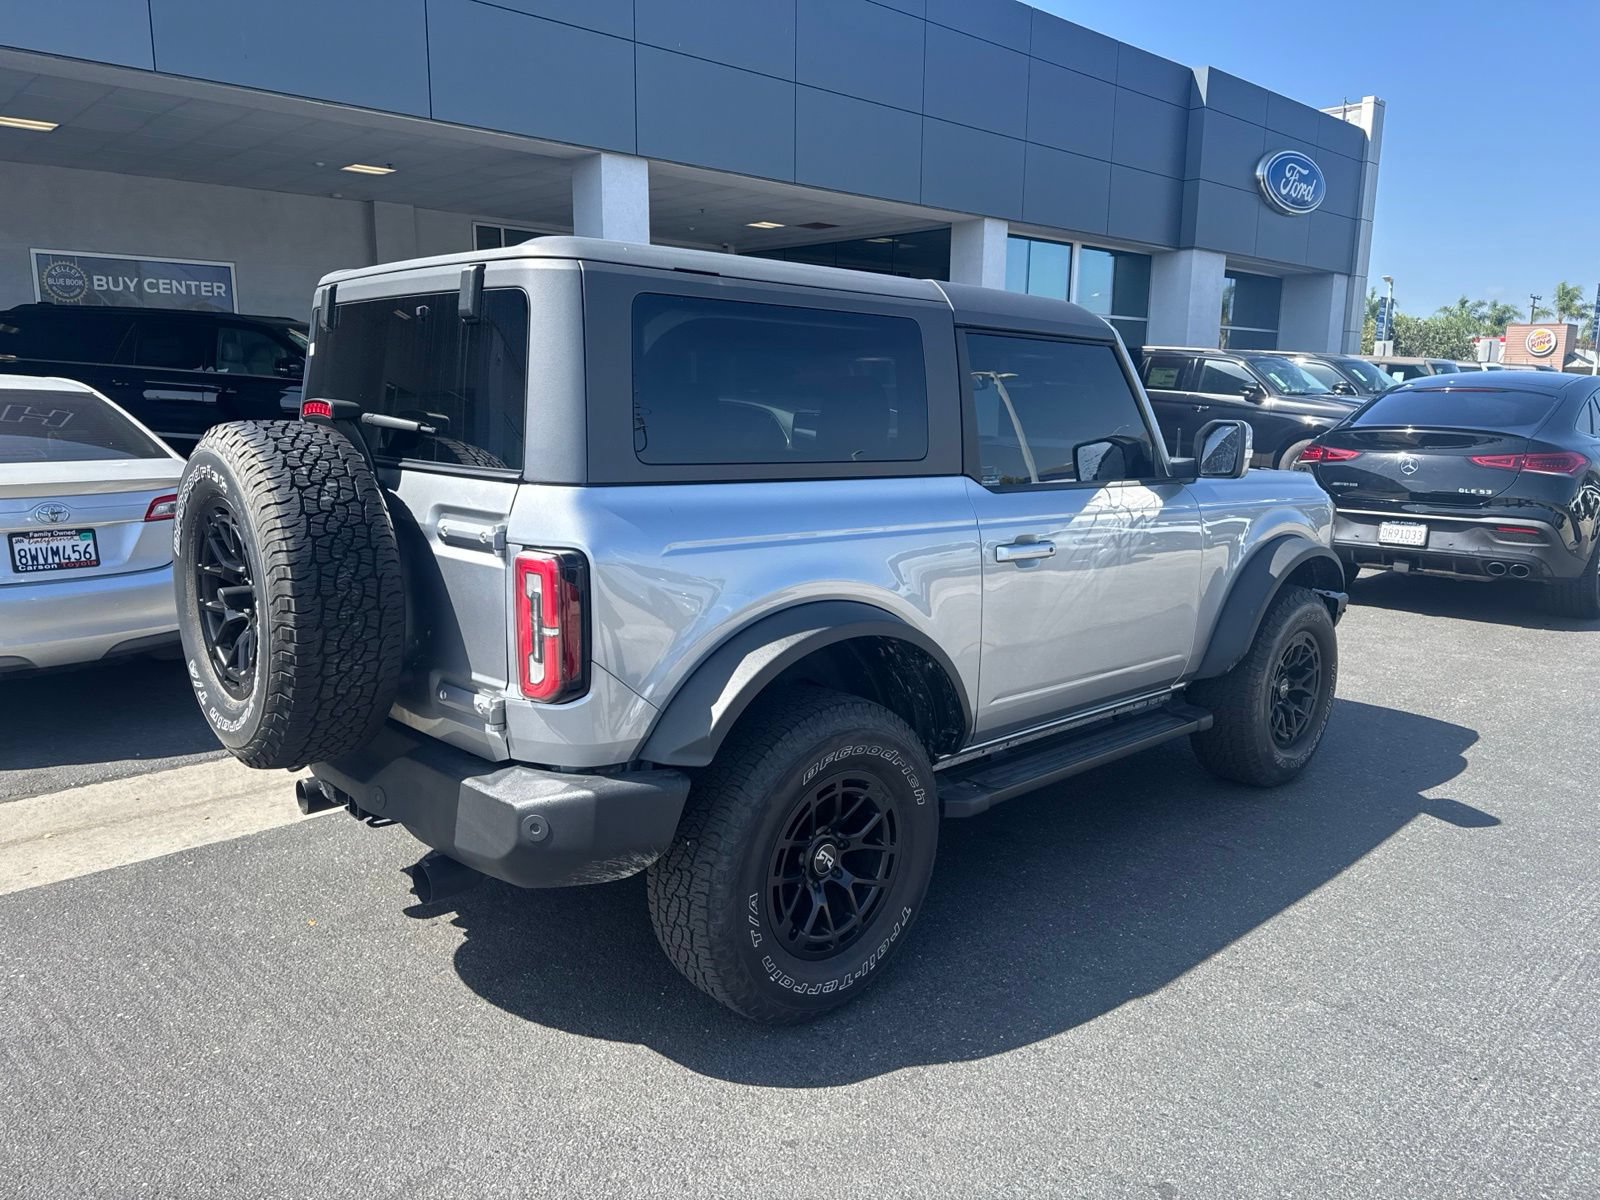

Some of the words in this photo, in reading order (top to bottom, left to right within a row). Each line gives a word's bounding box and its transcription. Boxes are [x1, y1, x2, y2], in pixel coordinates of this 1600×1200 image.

[1280, 163, 1316, 202] Ford
[51, 265, 81, 278] KELLEY
[47, 277, 65, 286] BLUE
[65, 278, 84, 287] BOOK
[93, 275, 139, 292] BUY
[143, 278, 226, 297] CENTER
[1531, 339, 1552, 349] KING
[29, 531, 51, 539] Family
[53, 529, 76, 537] Owned
[17, 543, 93, 565] 8WVM456
[18, 563, 58, 571] Carson
[62, 560, 97, 568] Toyota
[802, 744, 926, 806] BFGoodrich
[748, 892, 763, 948] T/A
